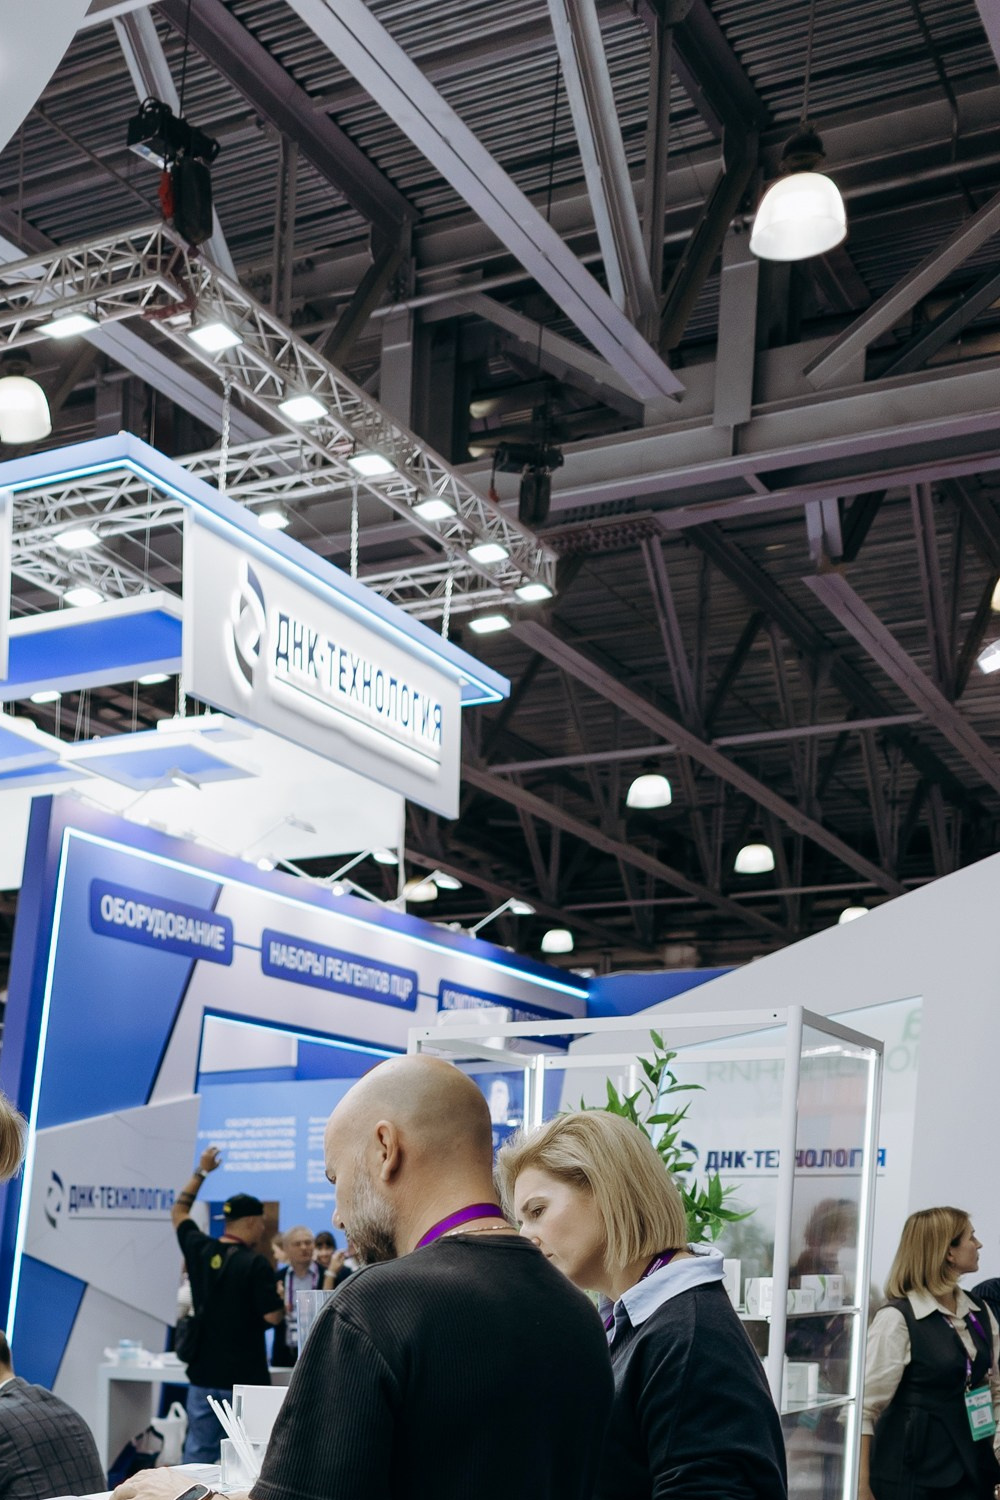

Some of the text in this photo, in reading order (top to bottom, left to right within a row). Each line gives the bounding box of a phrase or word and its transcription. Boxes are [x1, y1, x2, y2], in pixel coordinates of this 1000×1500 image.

[275, 611, 442, 746] ДНК-ТЕХНОЛОГИЯ
[101, 894, 225, 951] ОБОРУДОВАНИЕ
[269, 941, 325, 977] НАБОРЫ
[325, 956, 390, 994] РЕАГЕНТОВ
